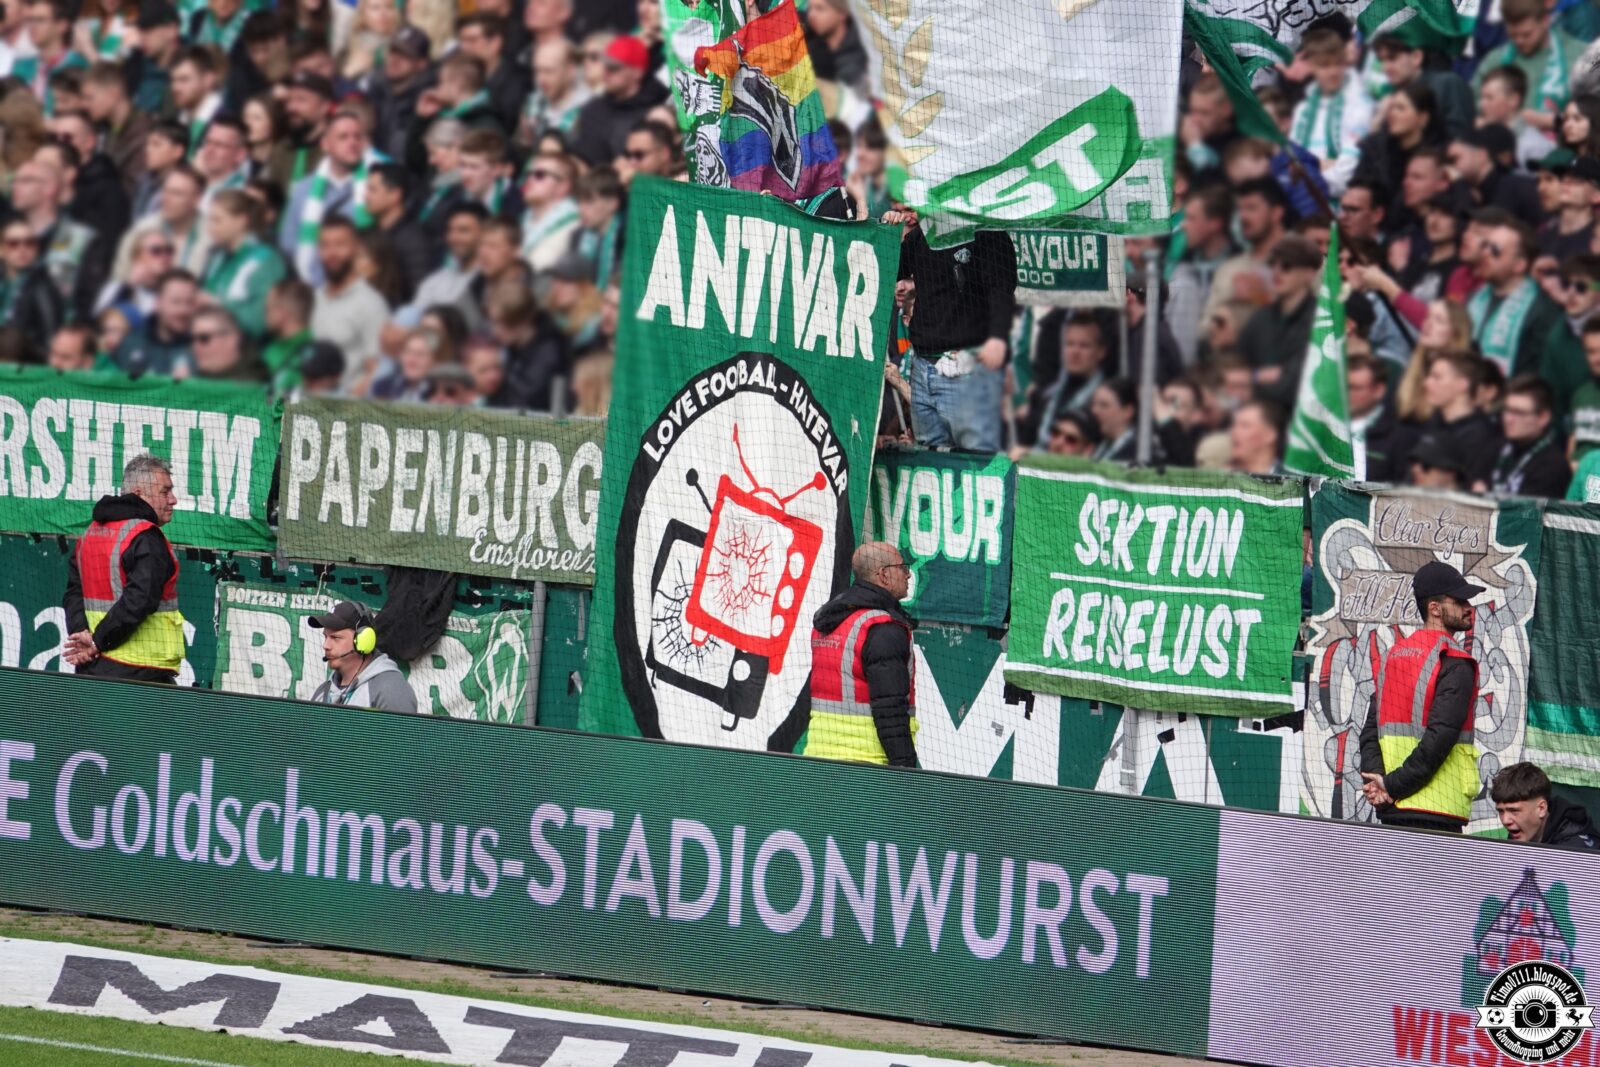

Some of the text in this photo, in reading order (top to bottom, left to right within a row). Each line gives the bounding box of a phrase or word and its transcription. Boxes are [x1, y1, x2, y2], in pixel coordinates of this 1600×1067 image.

[636, 204, 880, 361] ANTIVAR
[642, 390, 698, 463] LOVE
[286, 413, 603, 551] PAPENBURG
[1073, 491, 1245, 579] SEKTION
[1376, 500, 1483, 560] Clear Eyes
[1042, 587, 1263, 681] REISELUST
